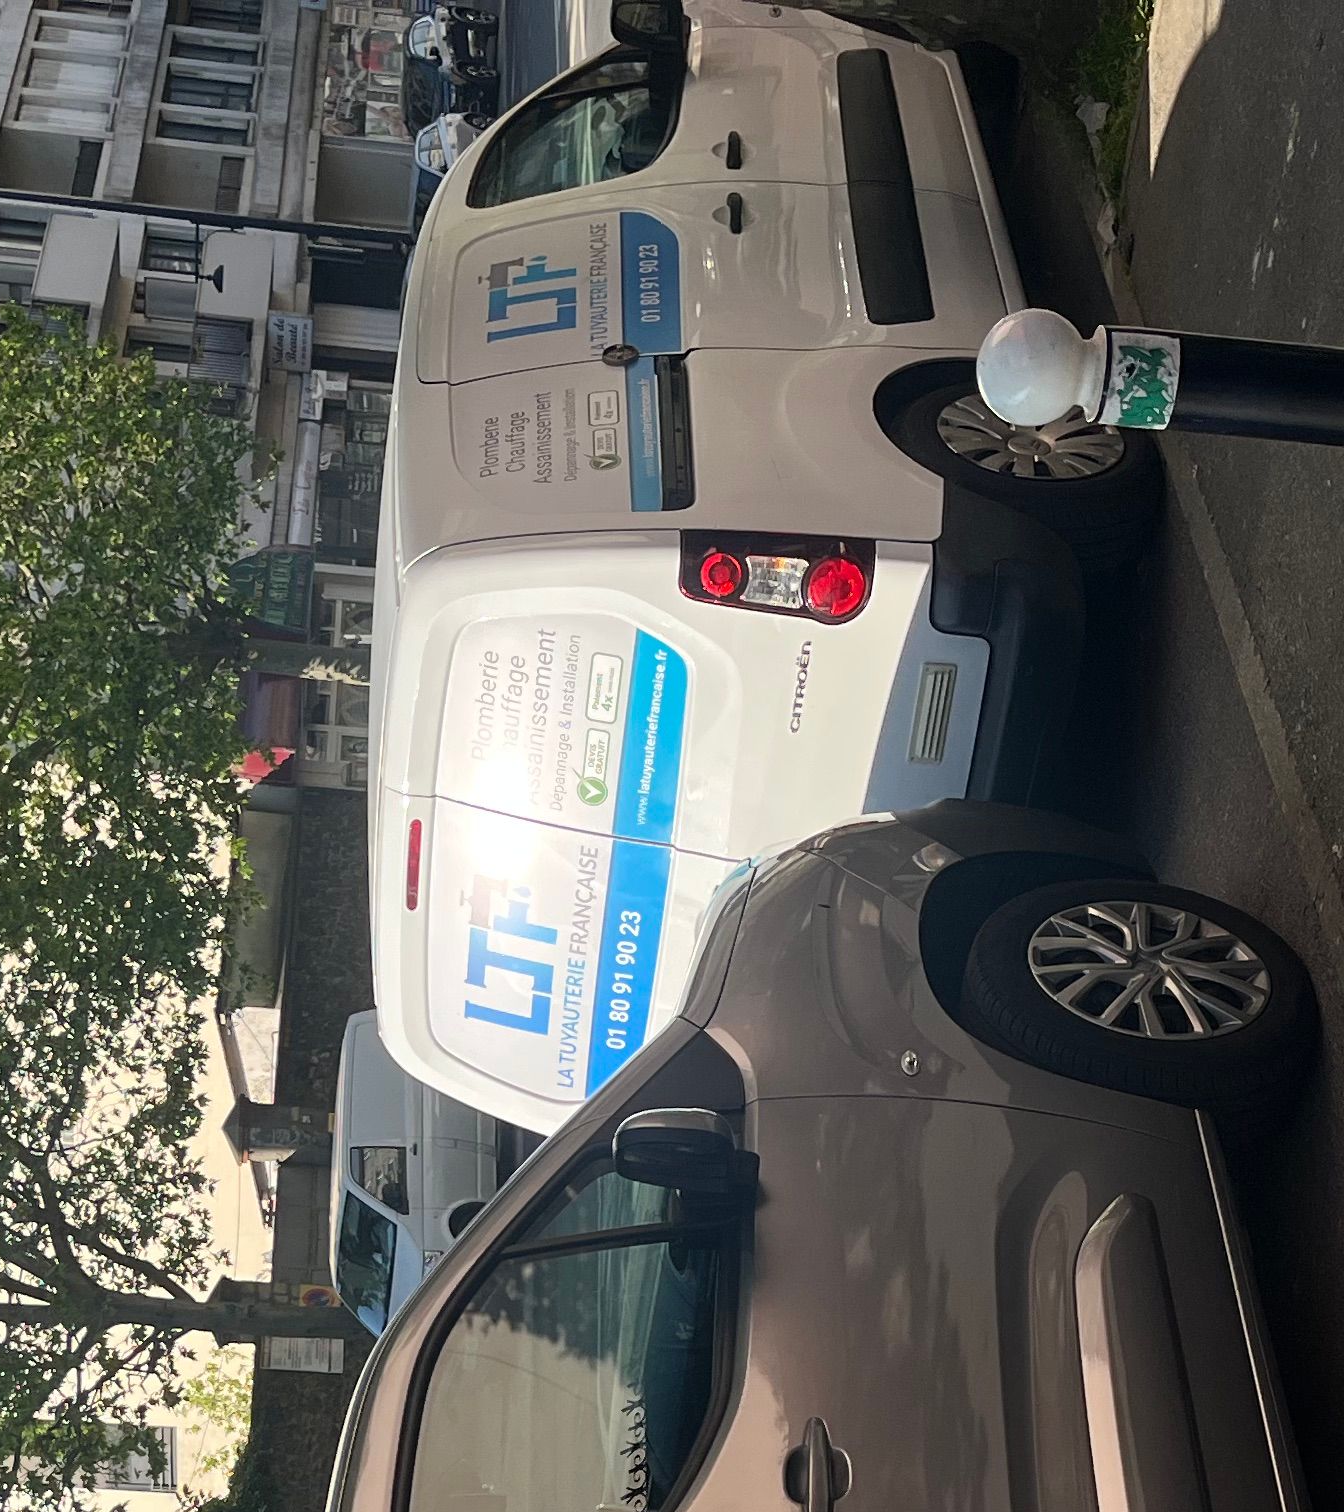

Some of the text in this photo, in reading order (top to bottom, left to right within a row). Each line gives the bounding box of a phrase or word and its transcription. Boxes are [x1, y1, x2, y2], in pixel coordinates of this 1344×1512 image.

[589, 222, 611, 276] FRANÇAISE
[589, 277, 608, 342] TUYAUTERIE
[638, 244, 661, 323] 01 80 91 90 23
[273, 318, 285, 332] de
[479, 416, 499, 478] Plomberie
[504, 411, 530, 473] Chauffage
[532, 392, 552, 483] Assainissement
[471, 650, 500, 760] Plomberie
[560, 634, 581, 716] Installation
[601, 695, 613, 712] 4x
[557, 719, 572, 730] &
[587, 743, 597, 768] DEVIS
[595, 738, 606, 775] GRATUIT
[556, 844, 600, 1089] LA TUYAUTERIE FRANÇAISE
[605, 909, 642, 1050] 01 80 91 90 23
